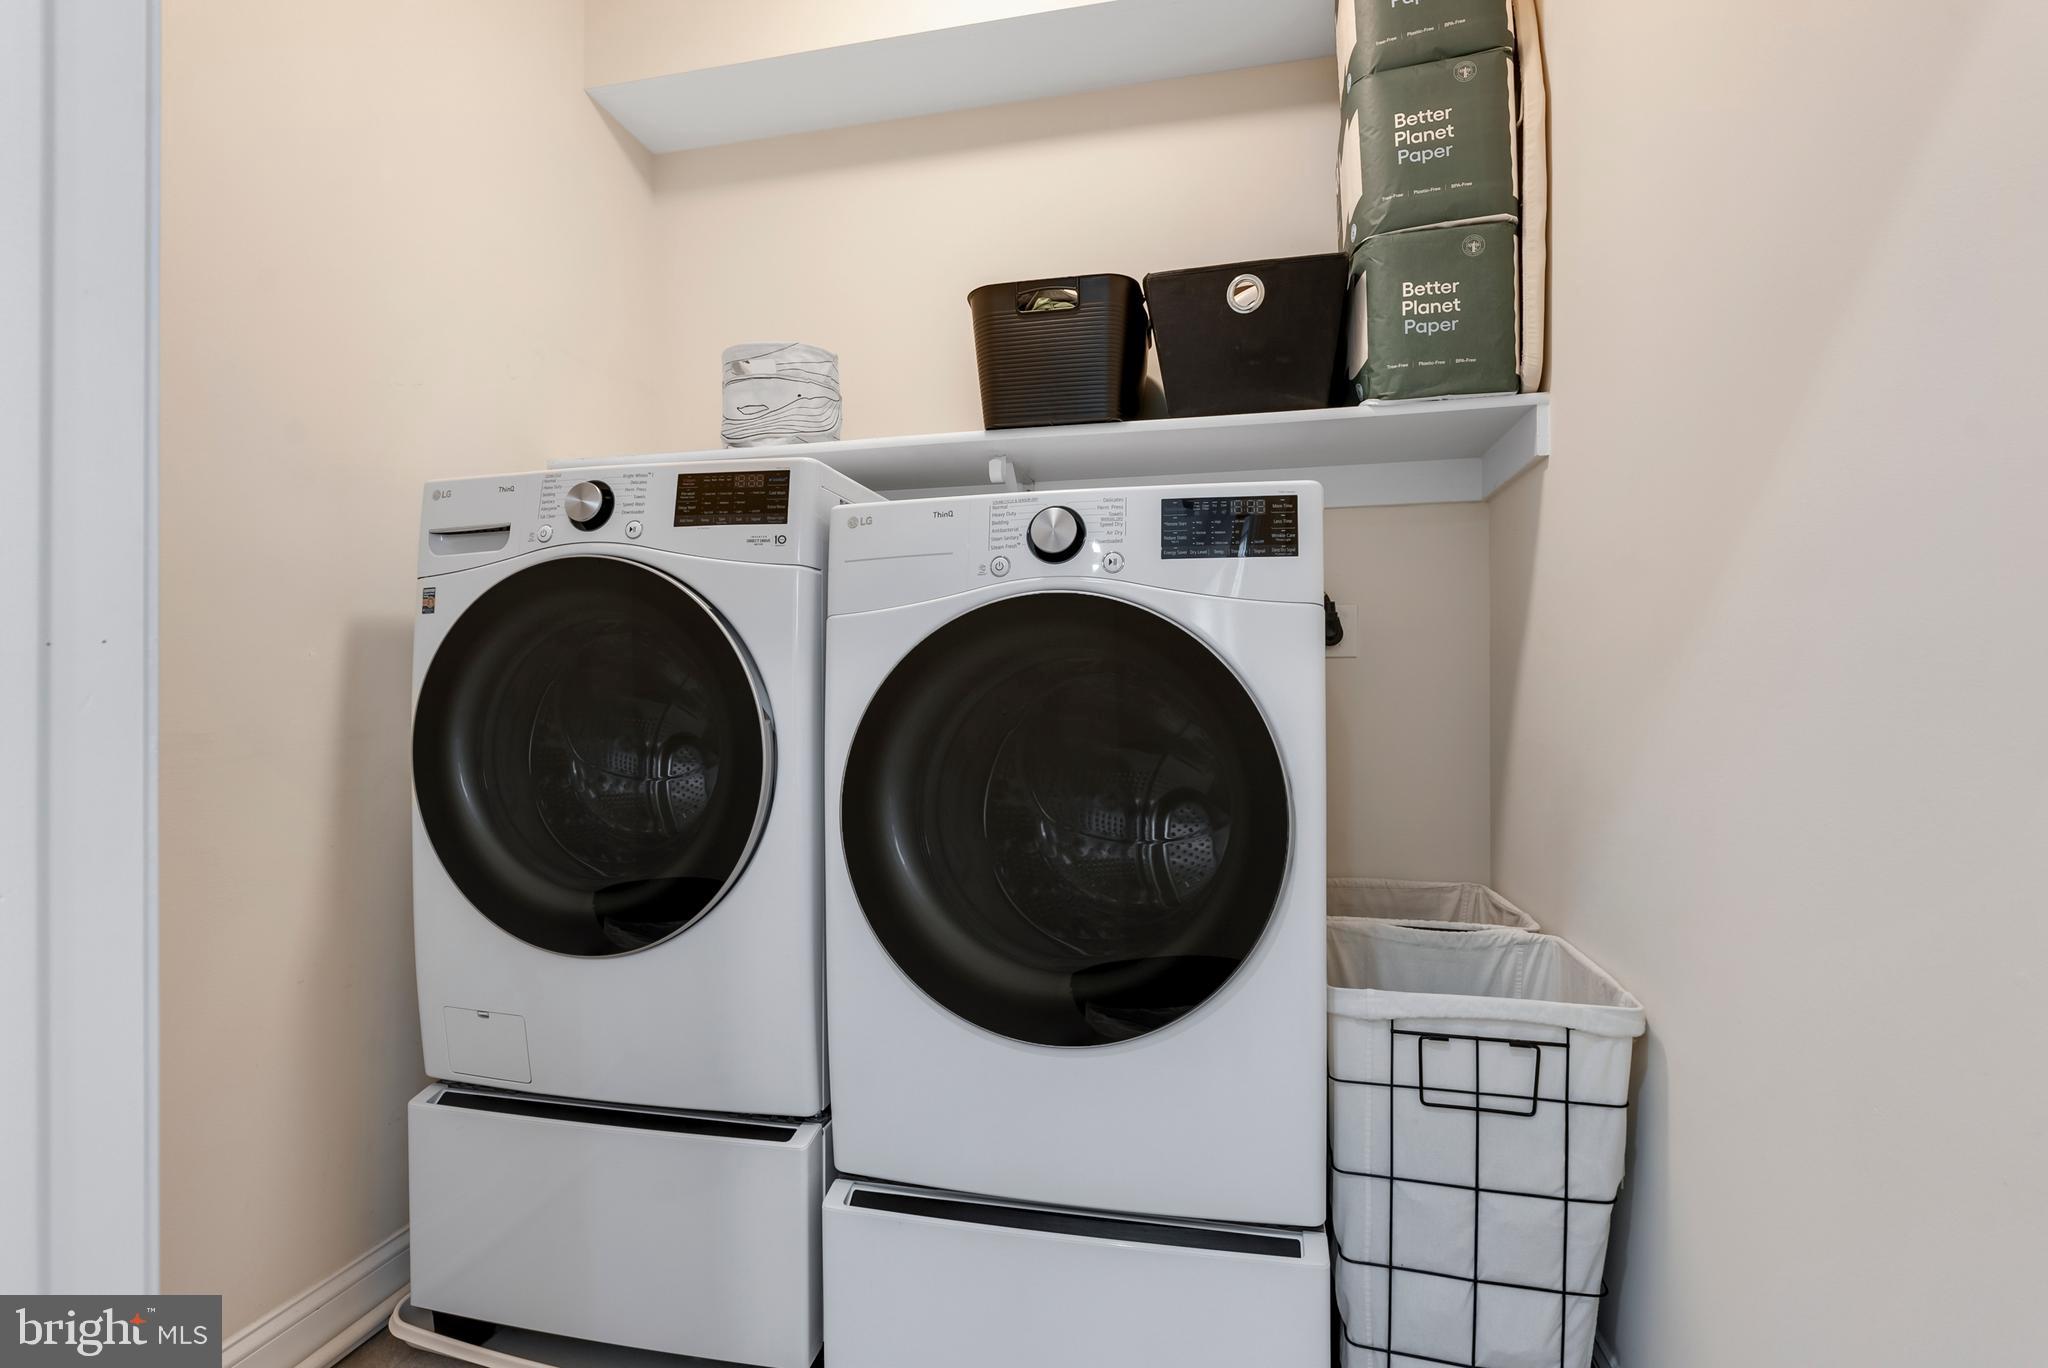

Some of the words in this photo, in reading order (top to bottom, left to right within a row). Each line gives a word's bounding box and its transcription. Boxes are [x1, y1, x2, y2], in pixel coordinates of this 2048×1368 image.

[1394, 107, 1453, 129] Better
[1394, 124, 1455, 147] Planet
[1398, 145, 1453, 165] Paper
[1402, 280, 1460, 298] Better
[1401, 298, 1461, 316] Planet
[1404, 318, 1459, 336] Paper
[441, 490, 452, 499] LG
[498, 485, 515, 493] ThinQ
[860, 516, 873, 526] LG
[932, 510, 954, 519] ThinQ
